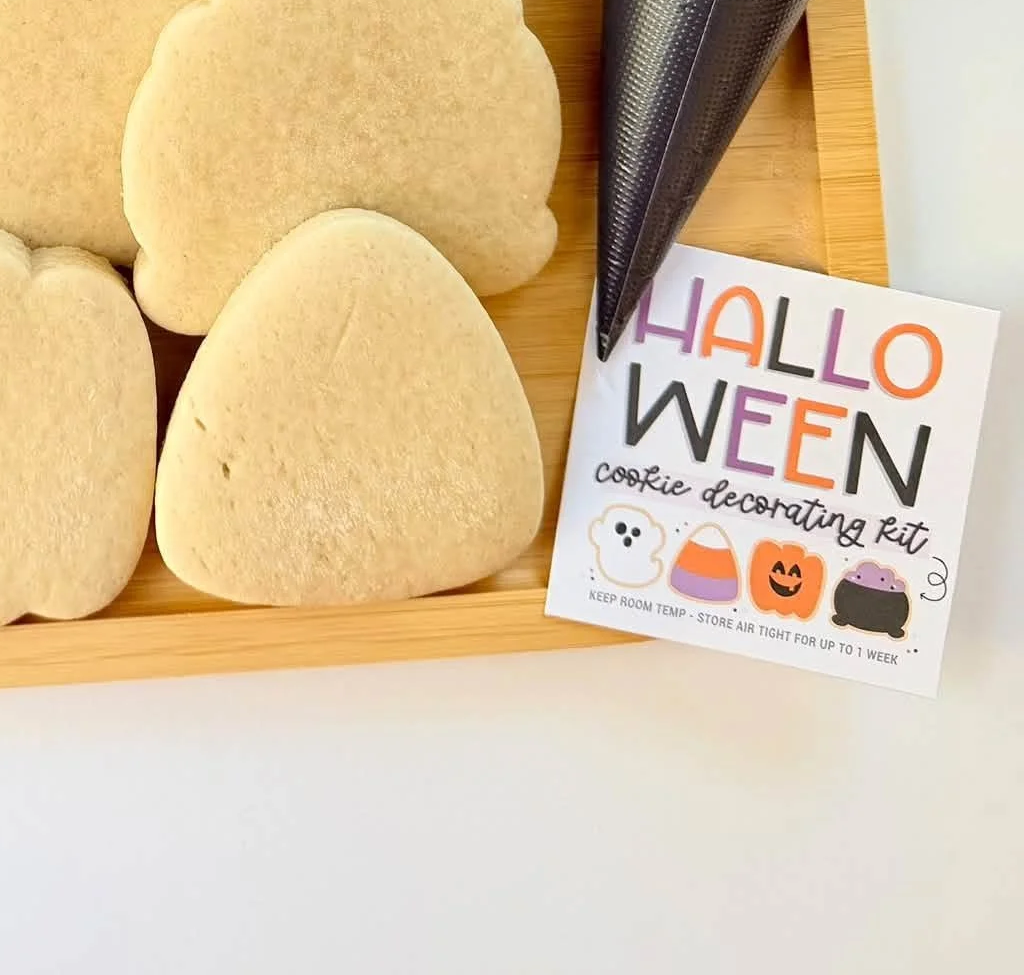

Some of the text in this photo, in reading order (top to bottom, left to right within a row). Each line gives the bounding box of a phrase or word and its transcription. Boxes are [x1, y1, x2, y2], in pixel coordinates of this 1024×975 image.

[633, 275, 944, 400] HALLO
[623, 361, 932, 509] WEEN
[594, 460, 930, 556] cookie decorating kit
[588, 589, 617, 606] KEEP
[619, 595, 653, 612] ROOM
[655, 602, 686, 618] TEMP
[696, 611, 733, 629] STORE
[735, 621, 755, 633] AIR
[758, 624, 791, 642] TIGHT
[793, 633, 816, 647] FOR
[819, 639, 836, 651] UP
[838, 642, 853, 655] TO
[866, 648, 899, 665] WEEK
